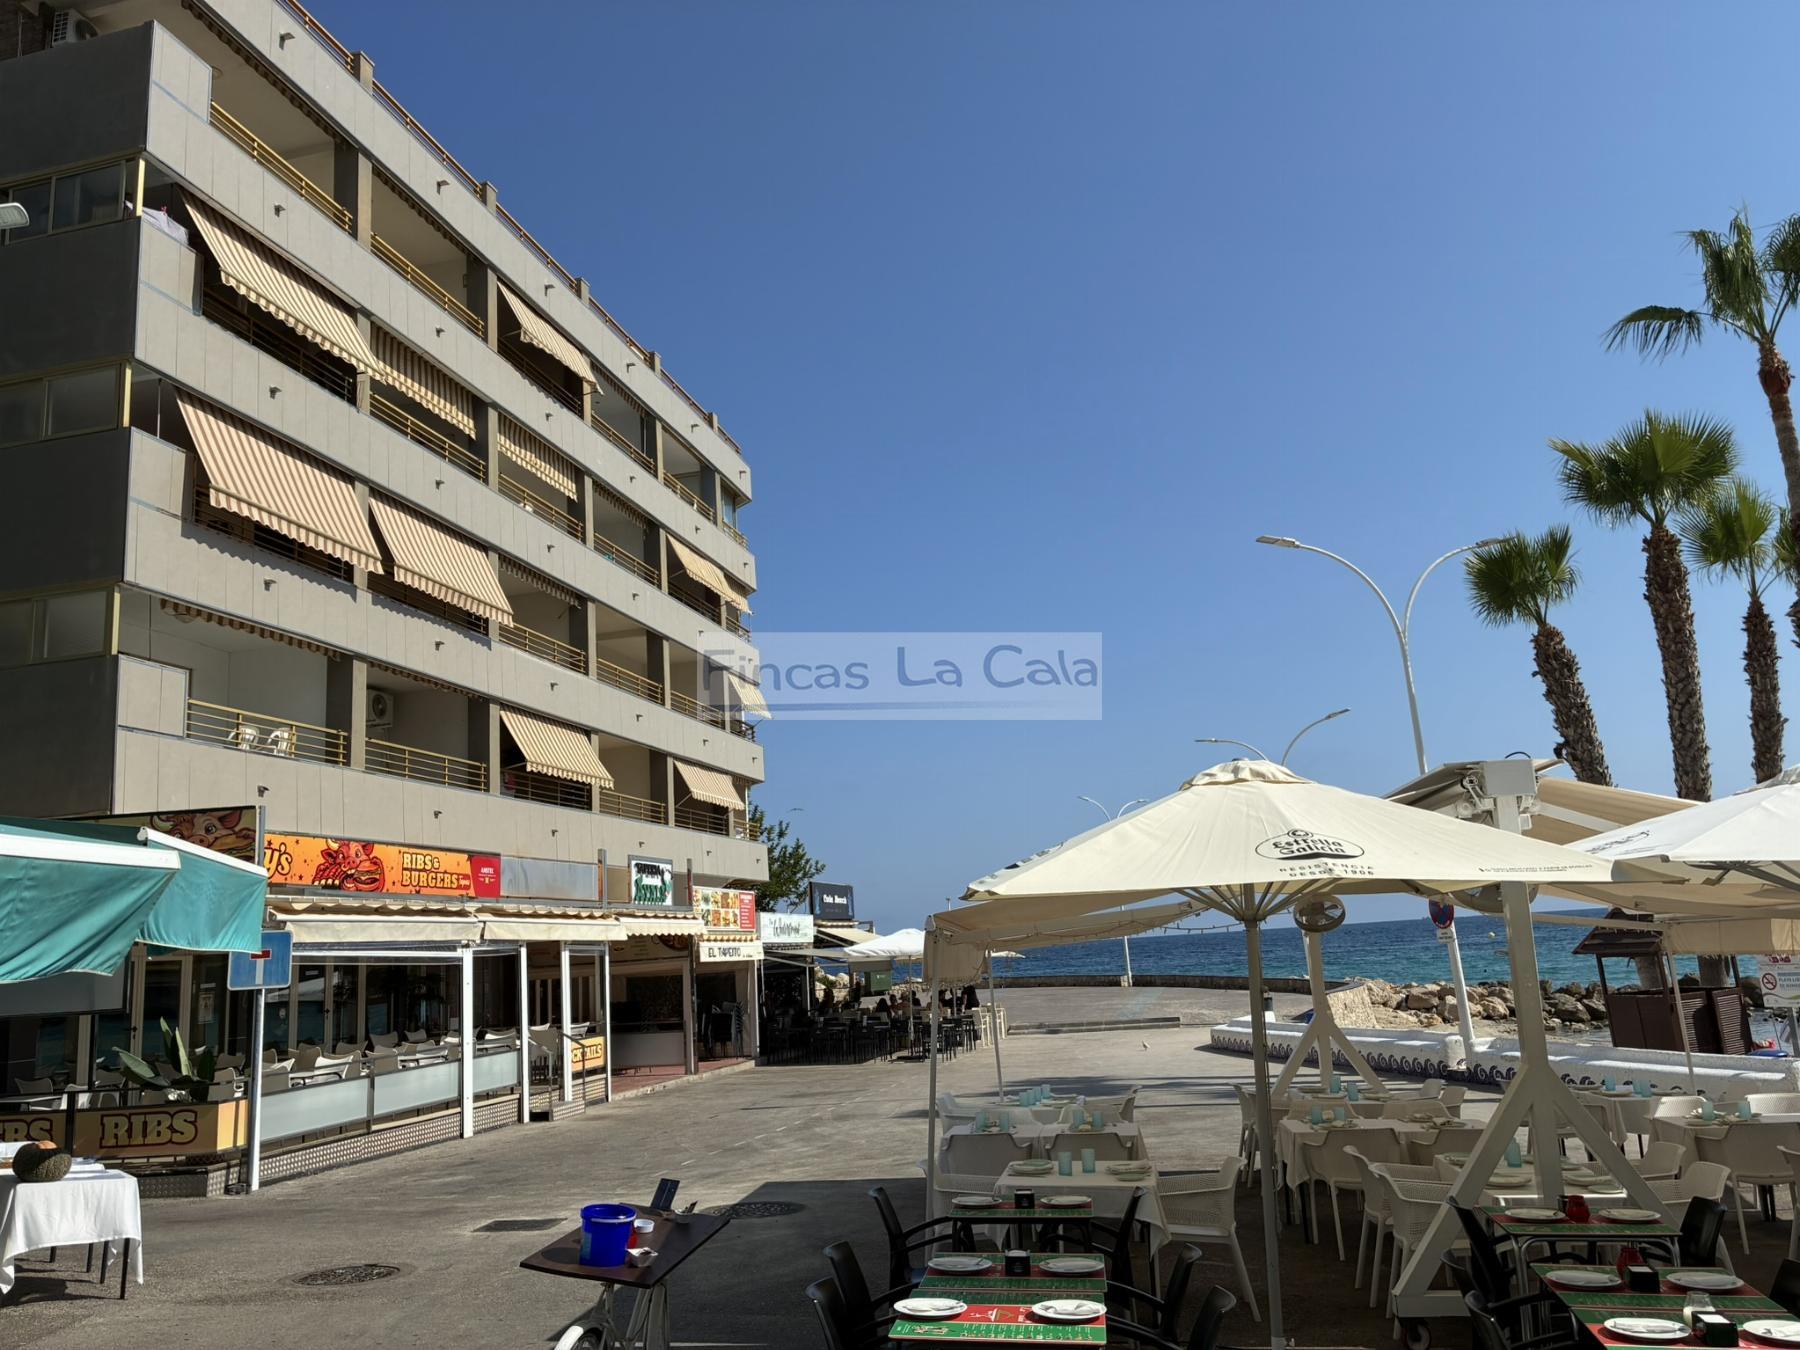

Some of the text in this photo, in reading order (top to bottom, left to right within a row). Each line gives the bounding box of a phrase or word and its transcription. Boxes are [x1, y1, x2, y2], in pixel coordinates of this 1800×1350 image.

[1272, 838, 1344, 849] Estrella
[1279, 845, 1347, 855] Galicia
[401, 851, 441, 871] RIBS &
[1343, 868, 1375, 876] 1906
[401, 871, 459, 888] BURGERS
[708, 947, 716, 958] EL
[0, 1118, 54, 1142] RS
[100, 1109, 198, 1149] RIBS
